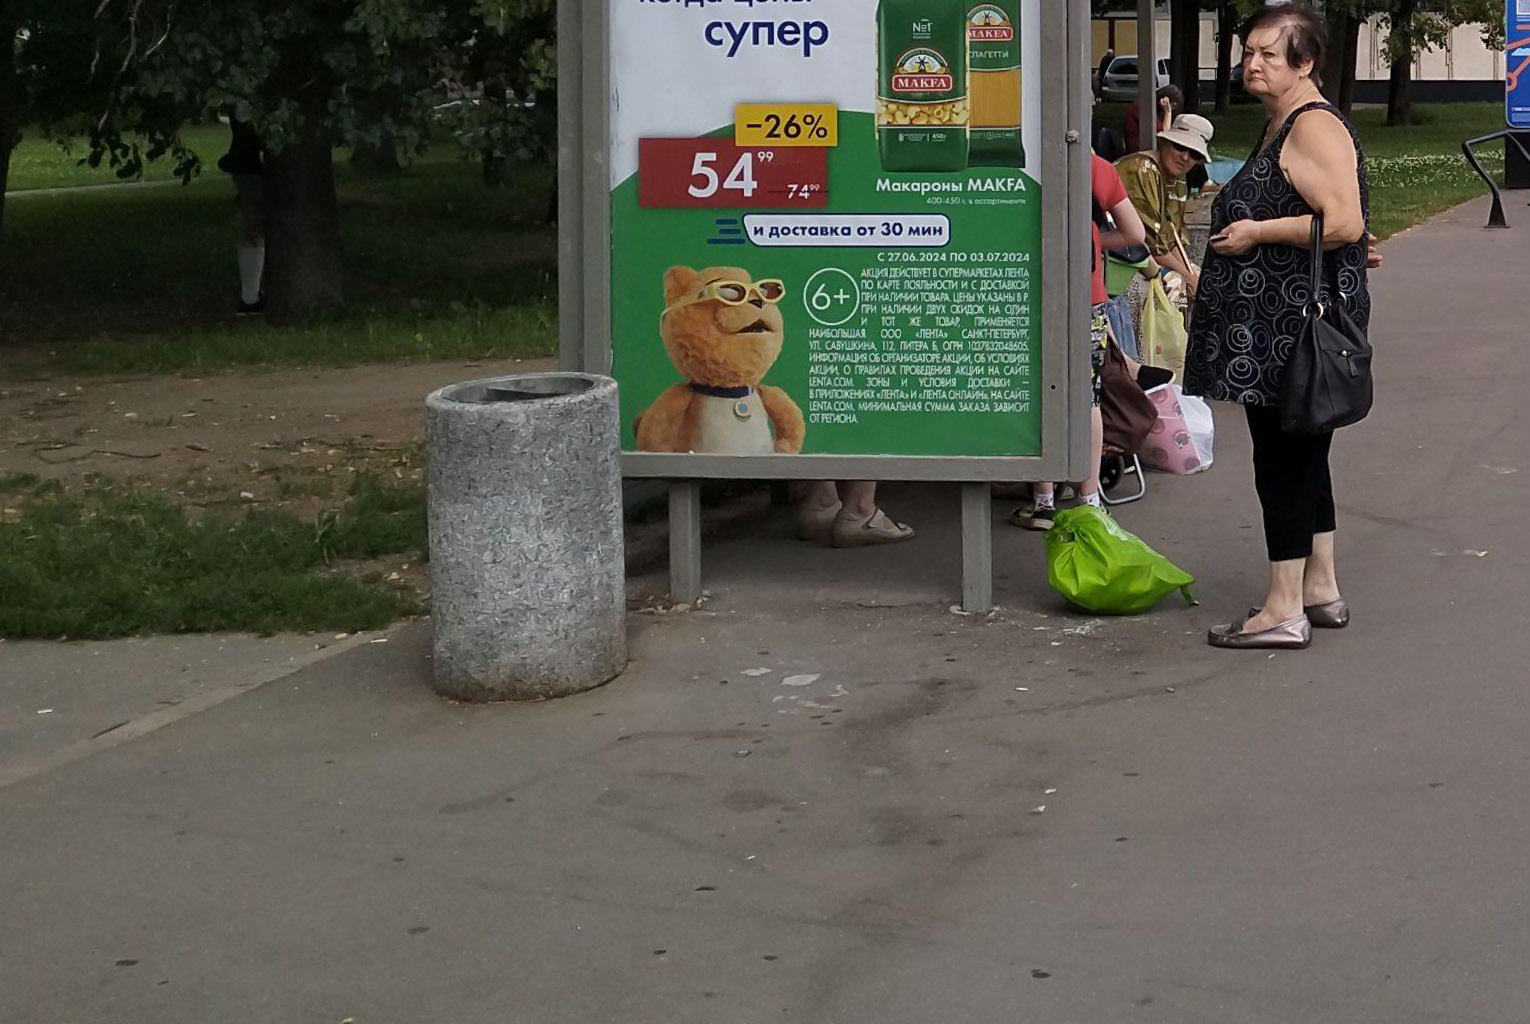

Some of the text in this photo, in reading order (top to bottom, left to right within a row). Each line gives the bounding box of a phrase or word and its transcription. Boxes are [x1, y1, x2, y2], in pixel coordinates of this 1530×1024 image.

[704, 20, 829, 57] супер
[897, 78, 947, 88] MAKFA
[687, 151, 774, 198] 54 99
[876, 178, 1026, 195] Макароны MAKFA
[926, 196, 960, 205] 400-450
[753, 222, 943, 239] и доставка от 30 мин
[877, 252, 1029, 262] С 27.06.2024 ПО 03.07.2024
[861, 268, 888, 278] АКЦИЯ
[889, 265, 931, 278] ДЕЙСТВУЕТ
[938, 268, 1003, 278] СУПЕРМАРКЕТАХ
[1004, 268, 1029, 278] ЛЕНТА
[861, 278, 1029, 291] ПО КАРТЕ ЛОЯЛЬНОСТИ И С ДОСТАВКОЙ
[811, 283, 850, 310] 6+
[861, 292, 877, 302] ПРИ
[878, 292, 918, 302] НАЛИЧИИ
[953, 292, 975, 303] ЦЕНЫ
[977, 292, 1015, 302] УКАЗАНЫ
[861, 304, 1029, 316] ПРИ НАЛИЧИИ ДВУХ СКИДОК НА ОДИН
[861, 316, 868, 326] И
[881, 316, 895, 326] ТОТ
[909, 316, 921, 326] ЖЕ
[881, 328, 902, 338] ООО
[868, 353, 880, 363] ОБ
[974, 353, 985, 363] ОБ
[843, 365, 851, 374] О
[955, 365, 984, 376] АКЦИИ
[988, 365, 1000, 374] НА
[1003, 363, 1029, 375] САЙТЕ
[866, 378, 890, 387] ЗОНЫ
[901, 378, 907, 387] И
[991, 390, 1002, 399] НА
[1004, 388, 1029, 400] САЙТЕ
[924, 402, 955, 412] СУММА
[958, 402, 990, 412] ЗАКАЗА
[809, 414, 819, 423] ОТ
